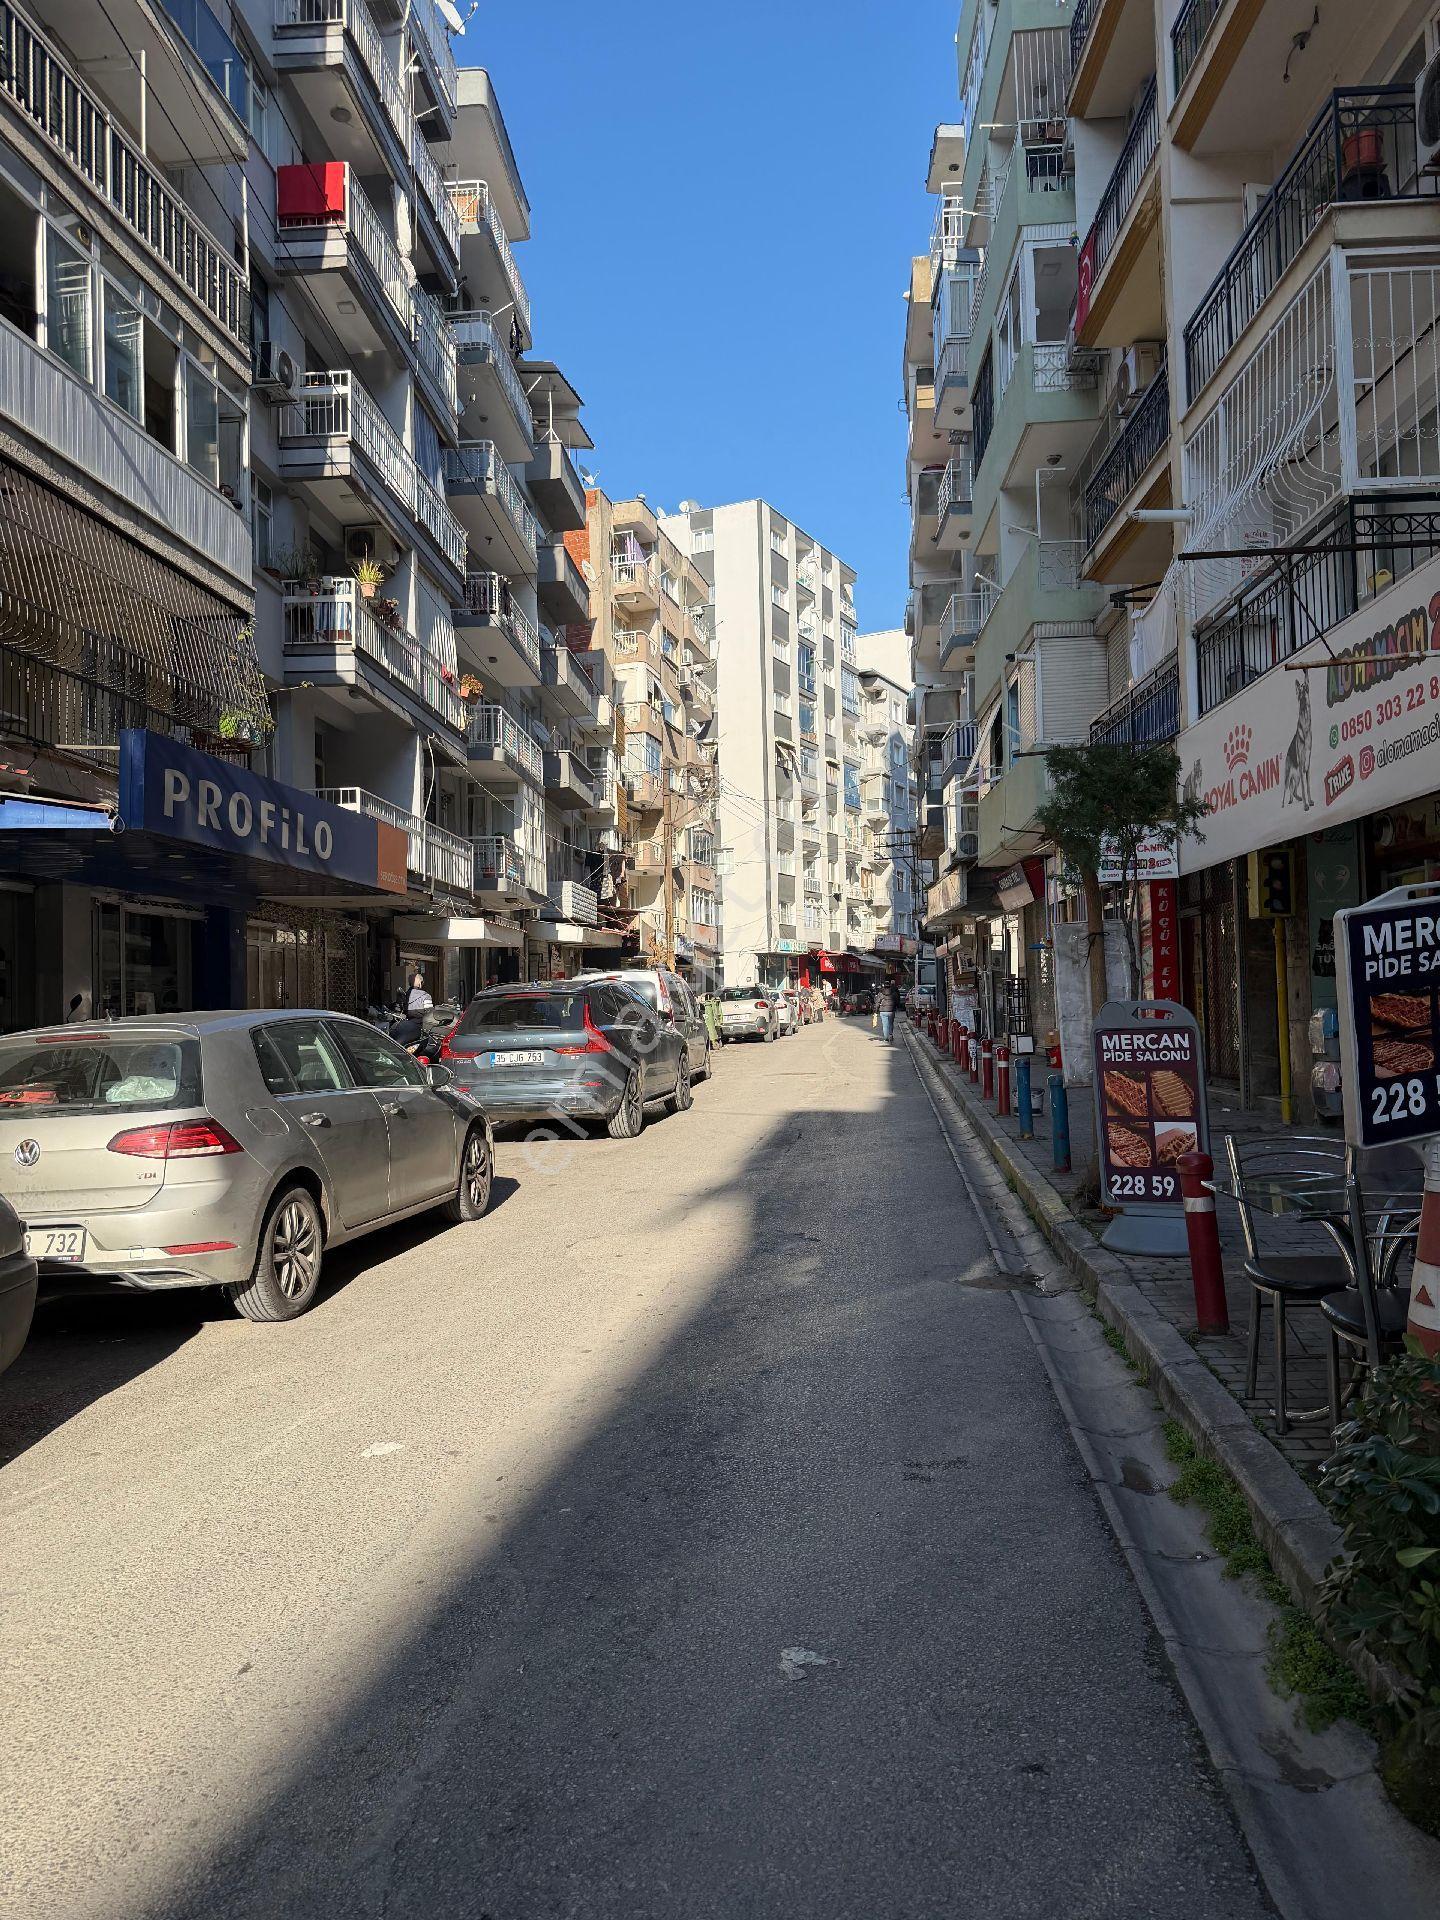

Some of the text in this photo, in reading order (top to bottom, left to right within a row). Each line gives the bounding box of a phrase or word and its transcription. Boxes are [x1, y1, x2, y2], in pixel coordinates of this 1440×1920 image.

[1341, 709, 1373, 742] 0850
[1377, 695, 1402, 726] 303
[1407, 683, 1426, 712] 22
[1161, 966, 1171, 988] EV
[1365, 953, 1412, 982] PİDE
[1102, 1033, 1190, 1051] MERCAN
[496, 1054, 506, 1063] 35
[1103, 1049, 1190, 1062] PİDE SALONU
[1371, 1078, 1427, 1125] 228
[136, 1172, 157, 1180] TDI
[1111, 1174, 1175, 1197] 228 59
[45, 1232, 78, 1254] 732
